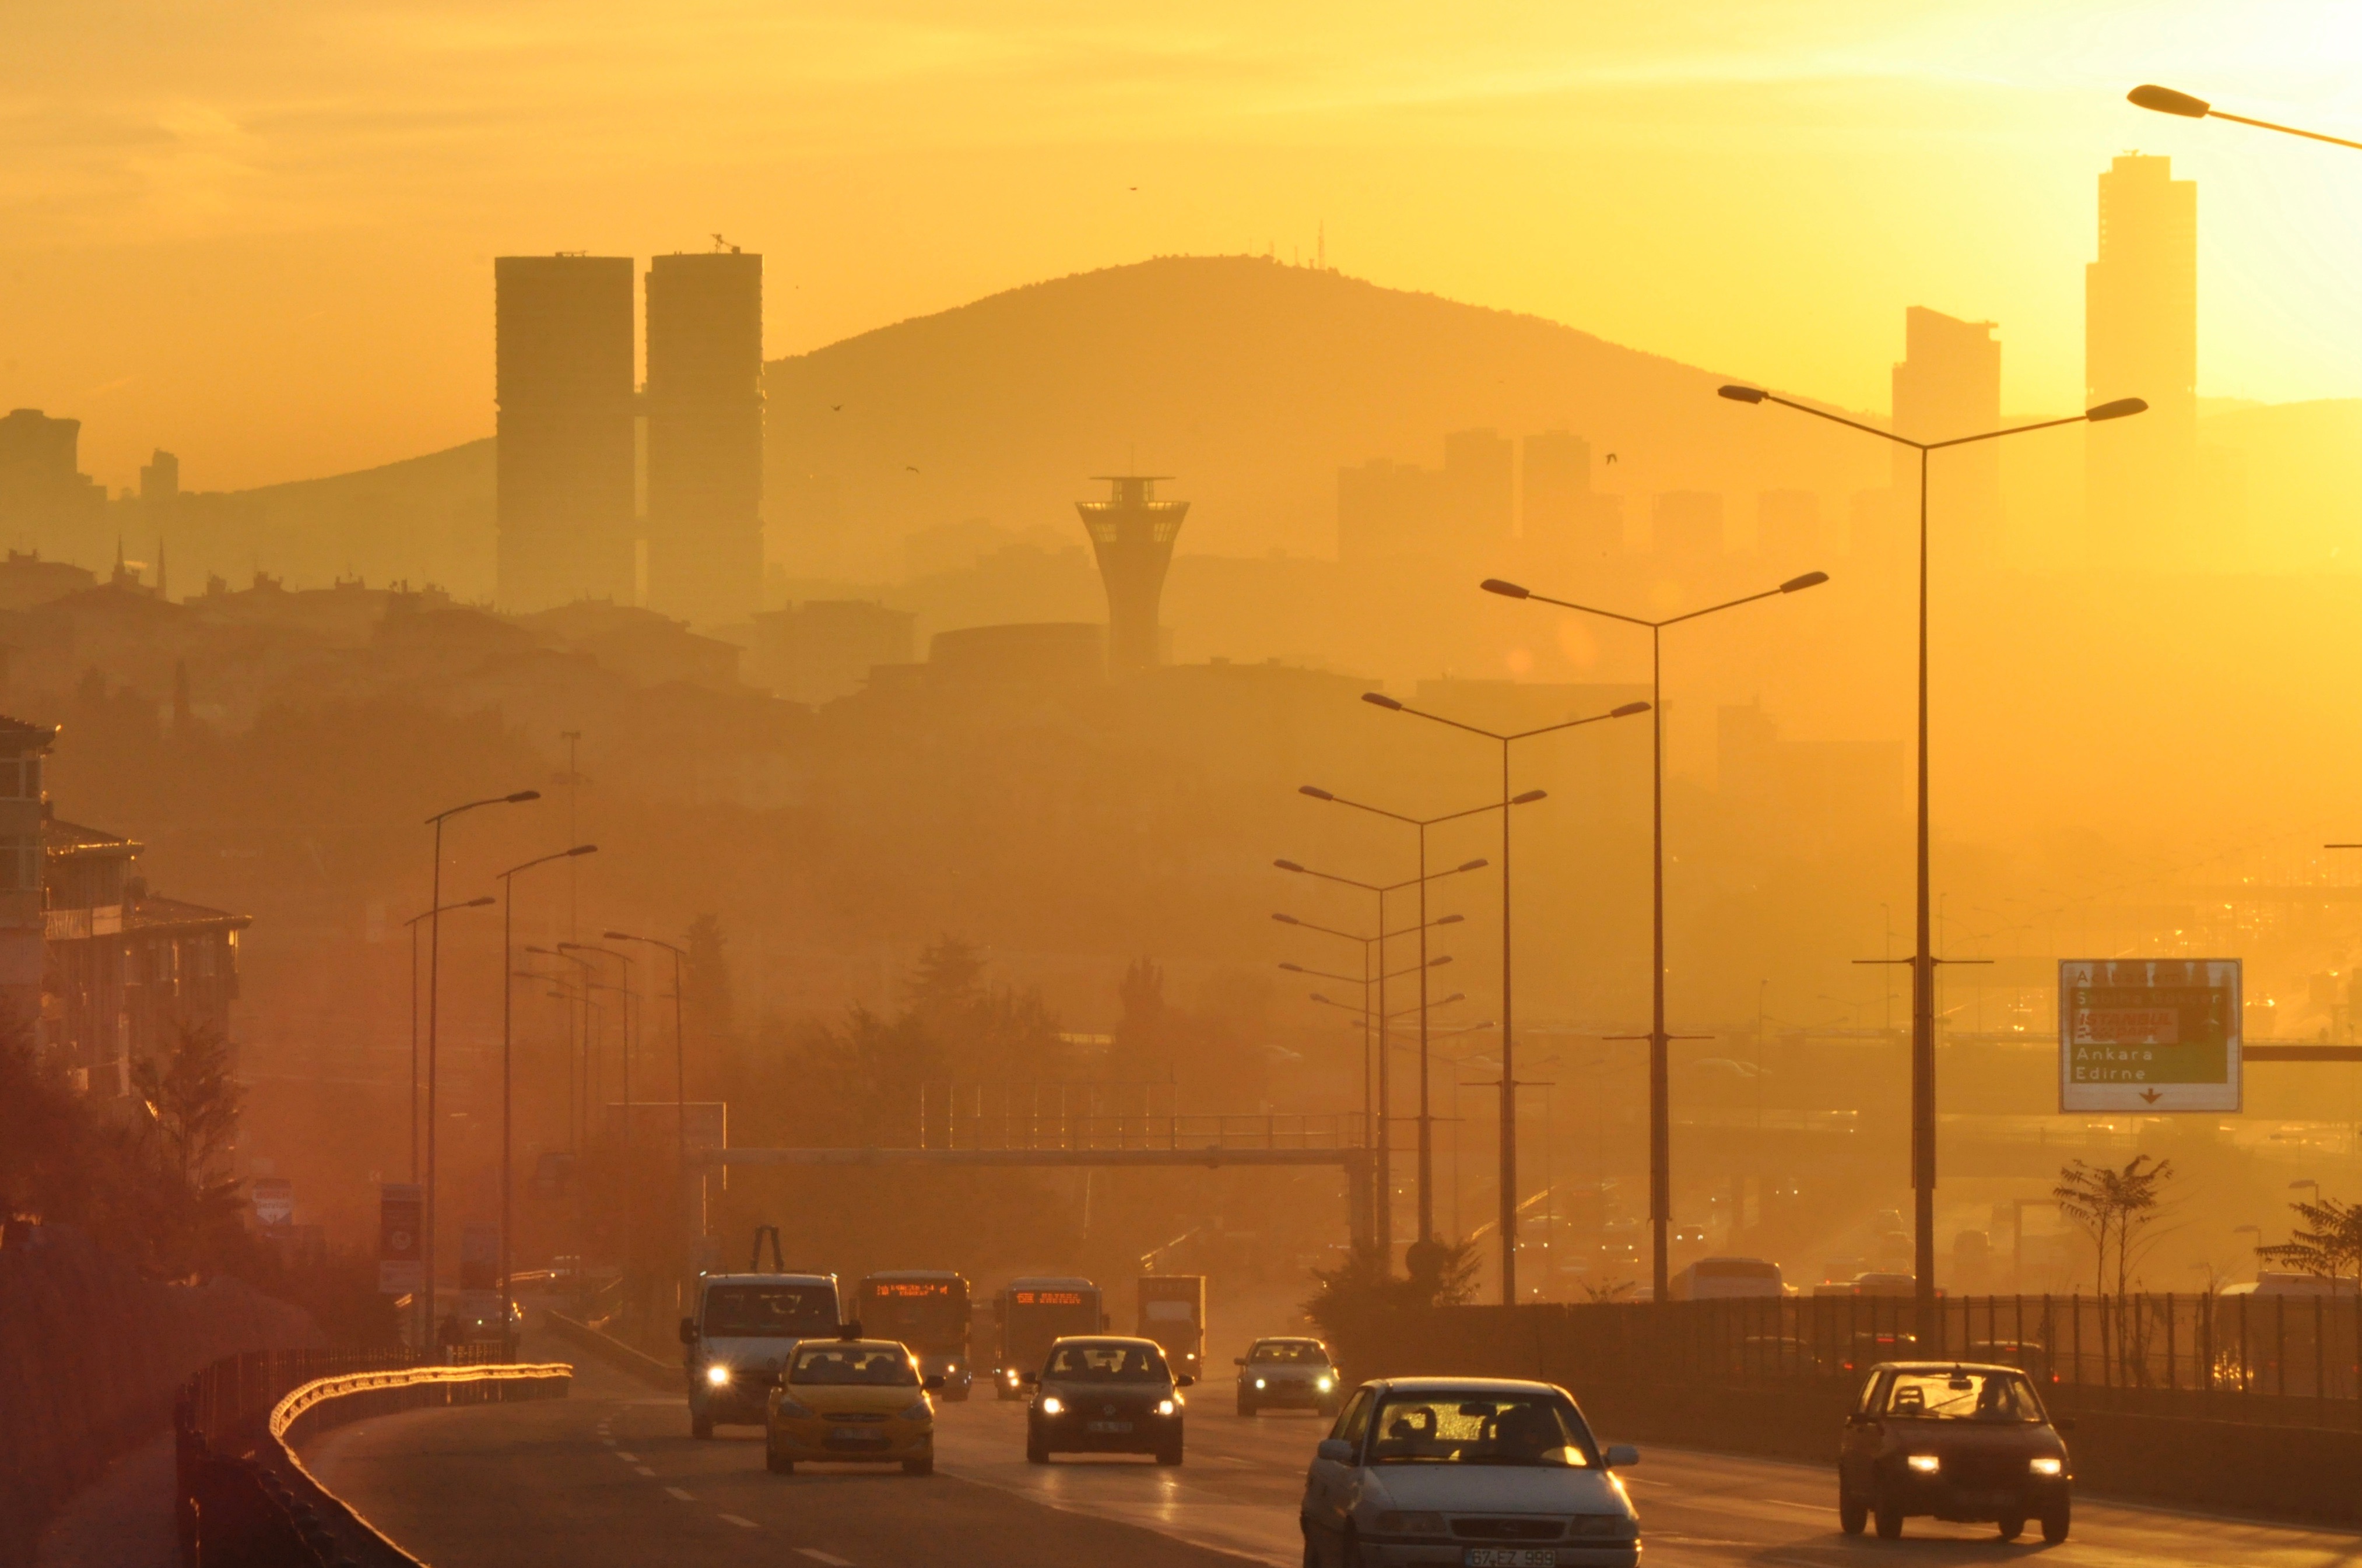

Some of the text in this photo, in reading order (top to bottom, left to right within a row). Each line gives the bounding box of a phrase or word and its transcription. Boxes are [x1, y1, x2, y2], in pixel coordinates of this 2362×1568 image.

[2076, 1047, 2153, 1061] Ankara
[2076, 1066, 2146, 1080] Edirne
[1472, 1550, 1491, 1566] 67
[1525, 1551, 1554, 1566] 999
